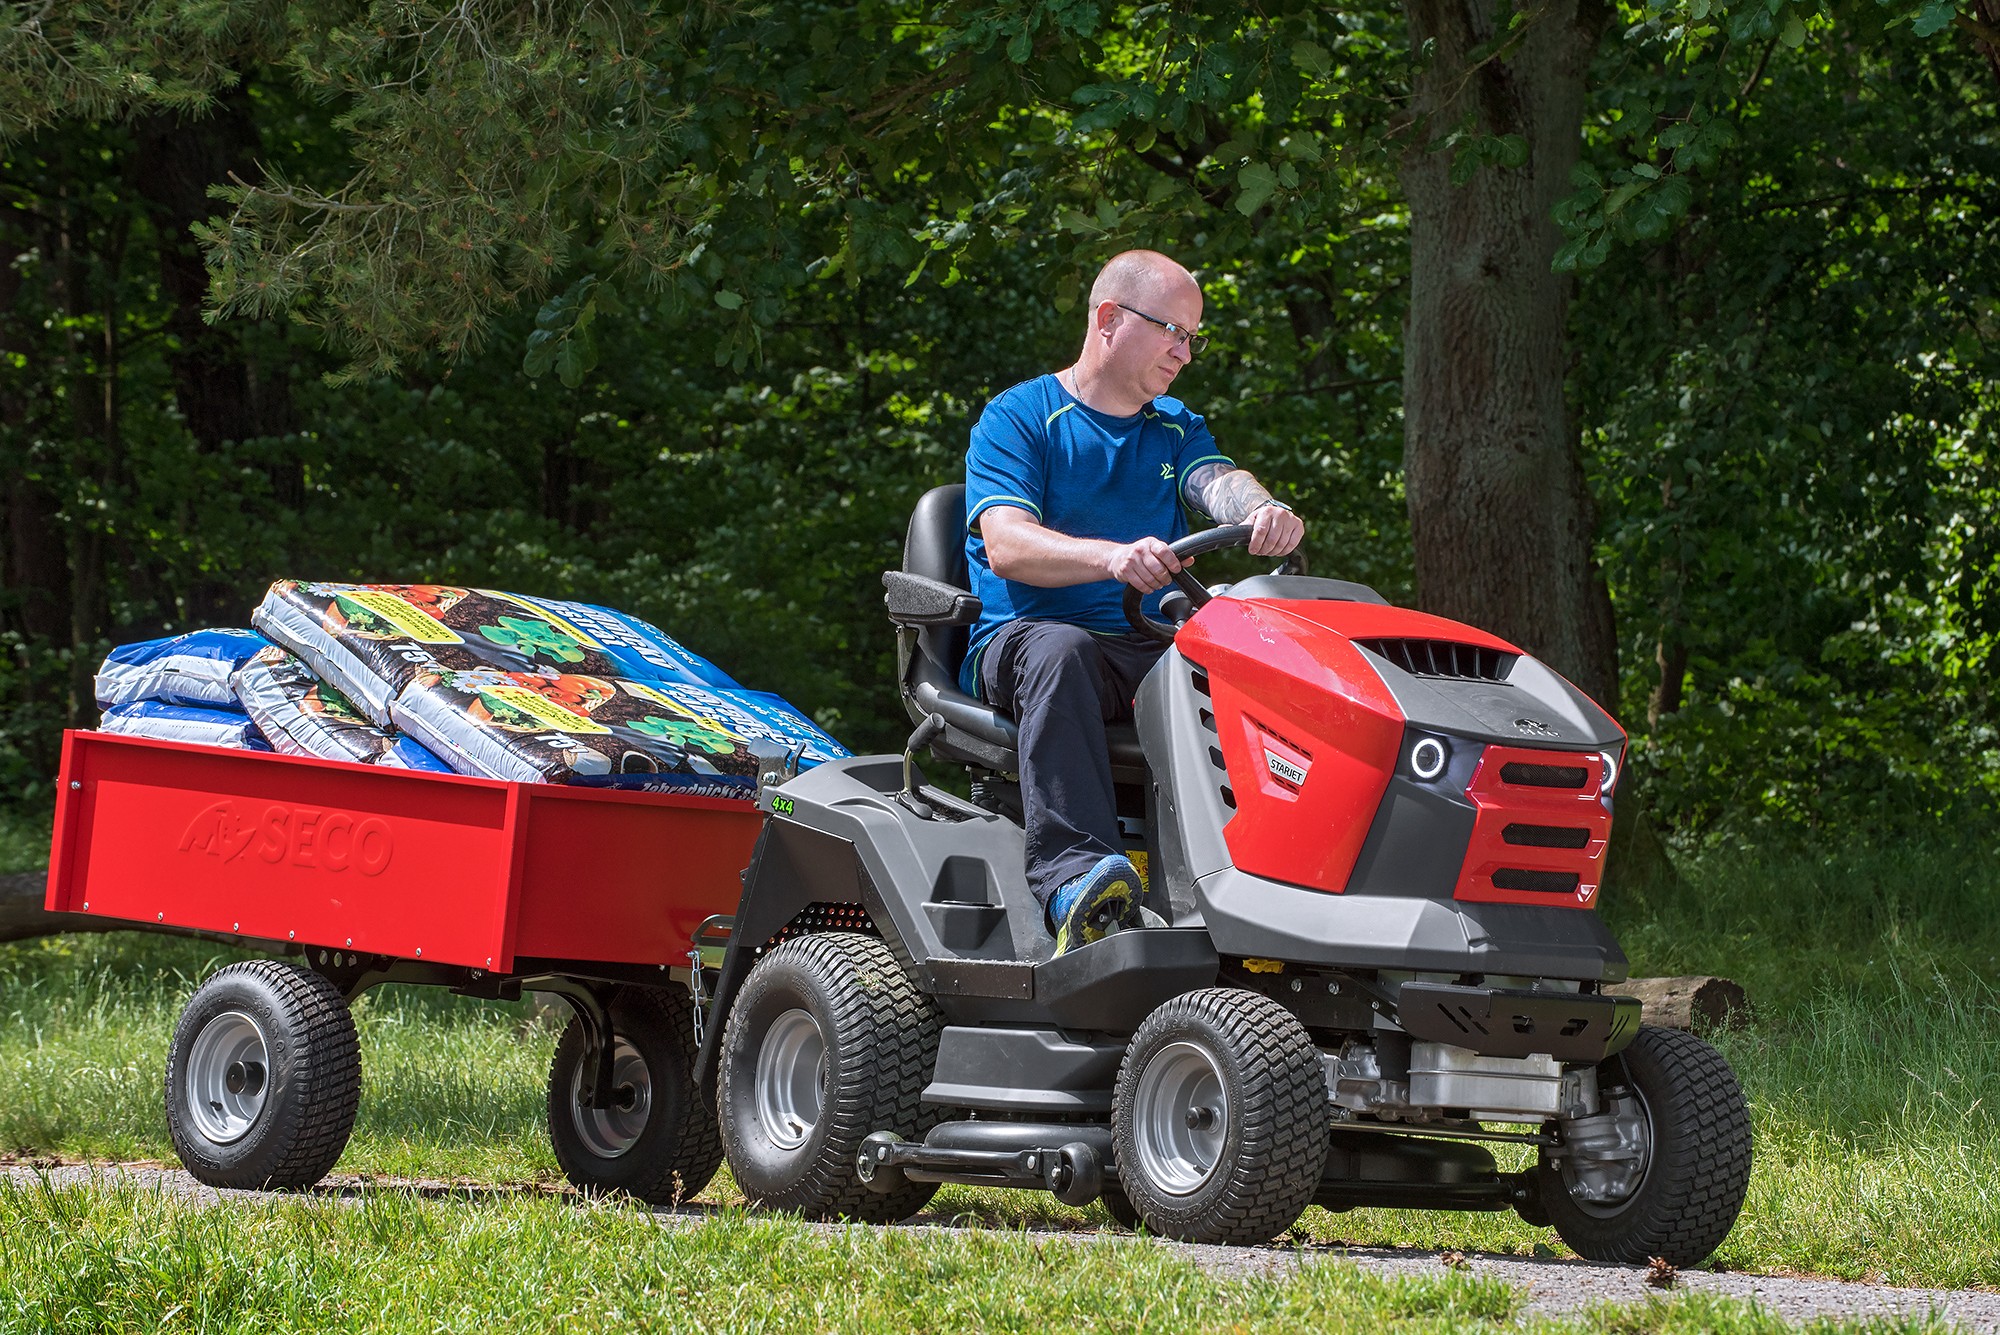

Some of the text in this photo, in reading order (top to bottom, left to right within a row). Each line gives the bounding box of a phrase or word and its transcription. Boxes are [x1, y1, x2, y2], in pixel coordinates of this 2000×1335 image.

[1270, 759, 1303, 781] STARJET
[771, 795, 795, 815] 4x4
[257, 805, 395, 878] SECO
